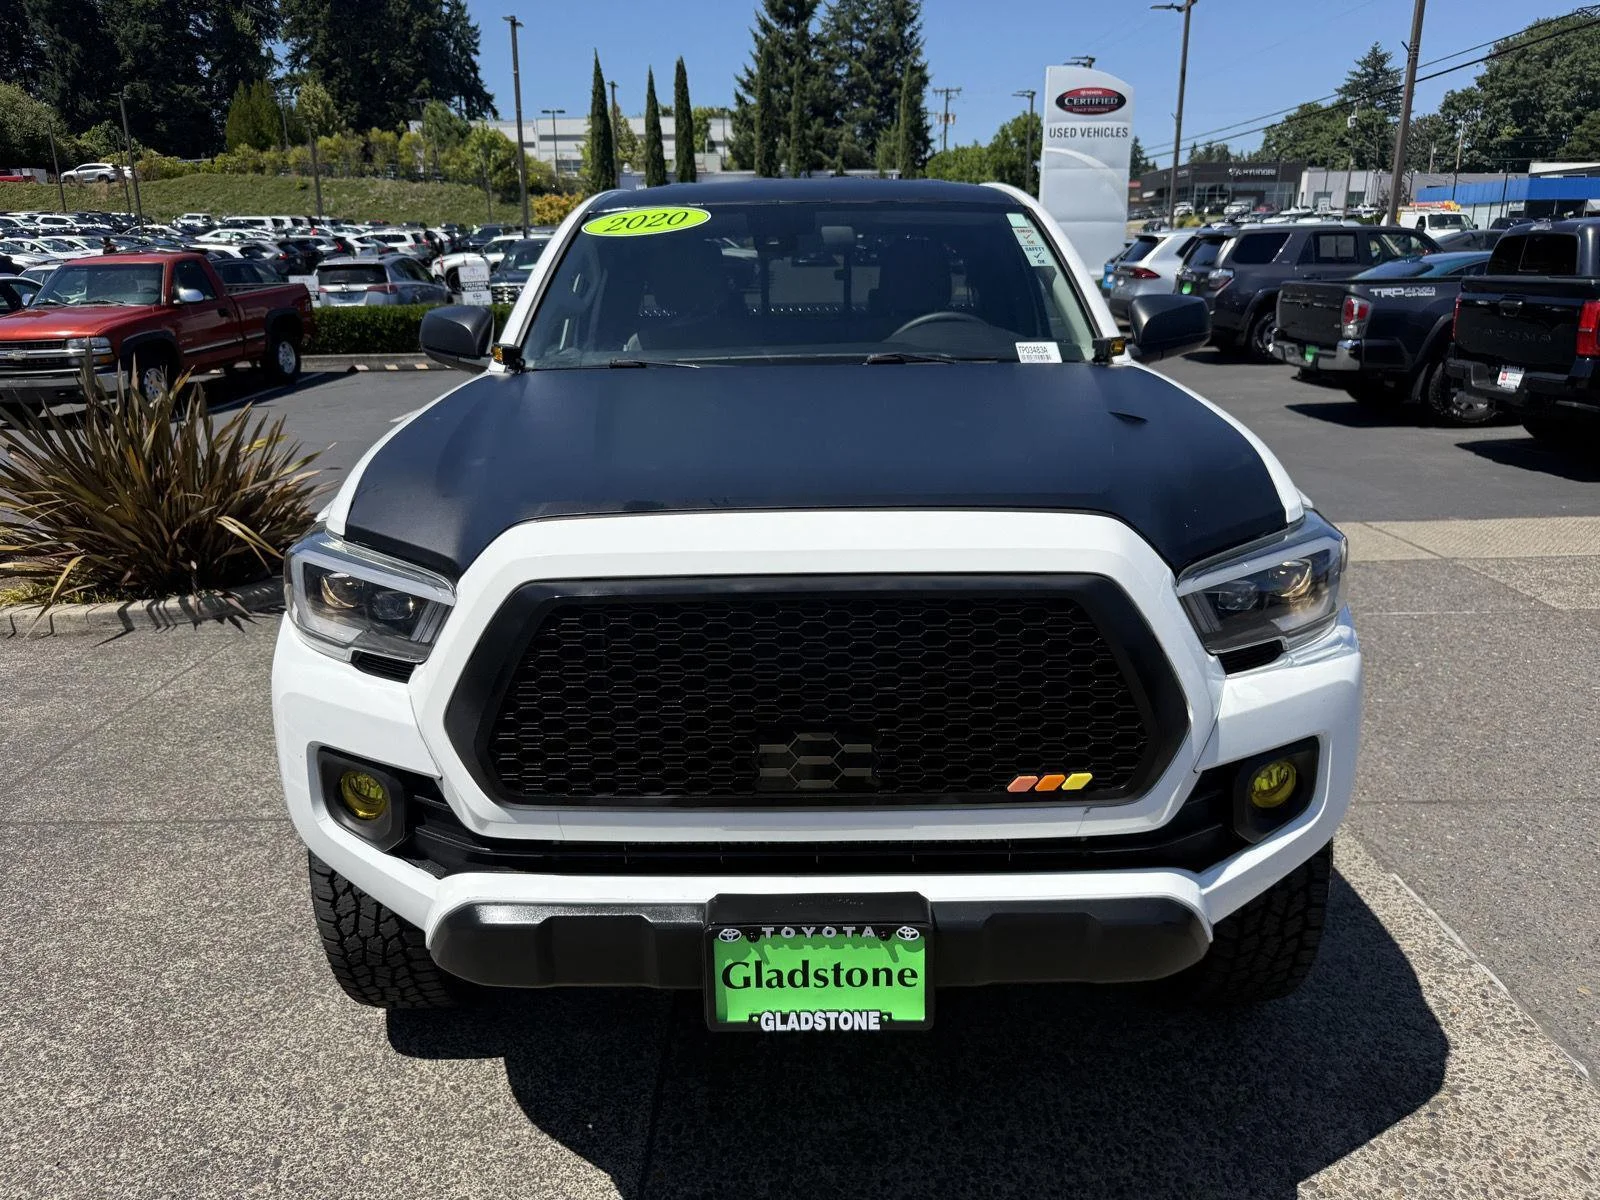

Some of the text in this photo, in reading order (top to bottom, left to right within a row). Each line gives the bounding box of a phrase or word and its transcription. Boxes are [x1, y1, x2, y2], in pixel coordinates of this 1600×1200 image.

[1064, 96, 1118, 106] CERTIFIED
[1049, 127, 1128, 139] USED VEHICLES
[1243, 168, 1277, 176] HYUNDAI
[602, 211, 689, 233] 2020
[1369, 287, 1405, 298] TRD
[762, 926, 877, 939] TOYOTA
[721, 959, 919, 989] Gladstone
[760, 1011, 881, 1032] GLADSTONE
